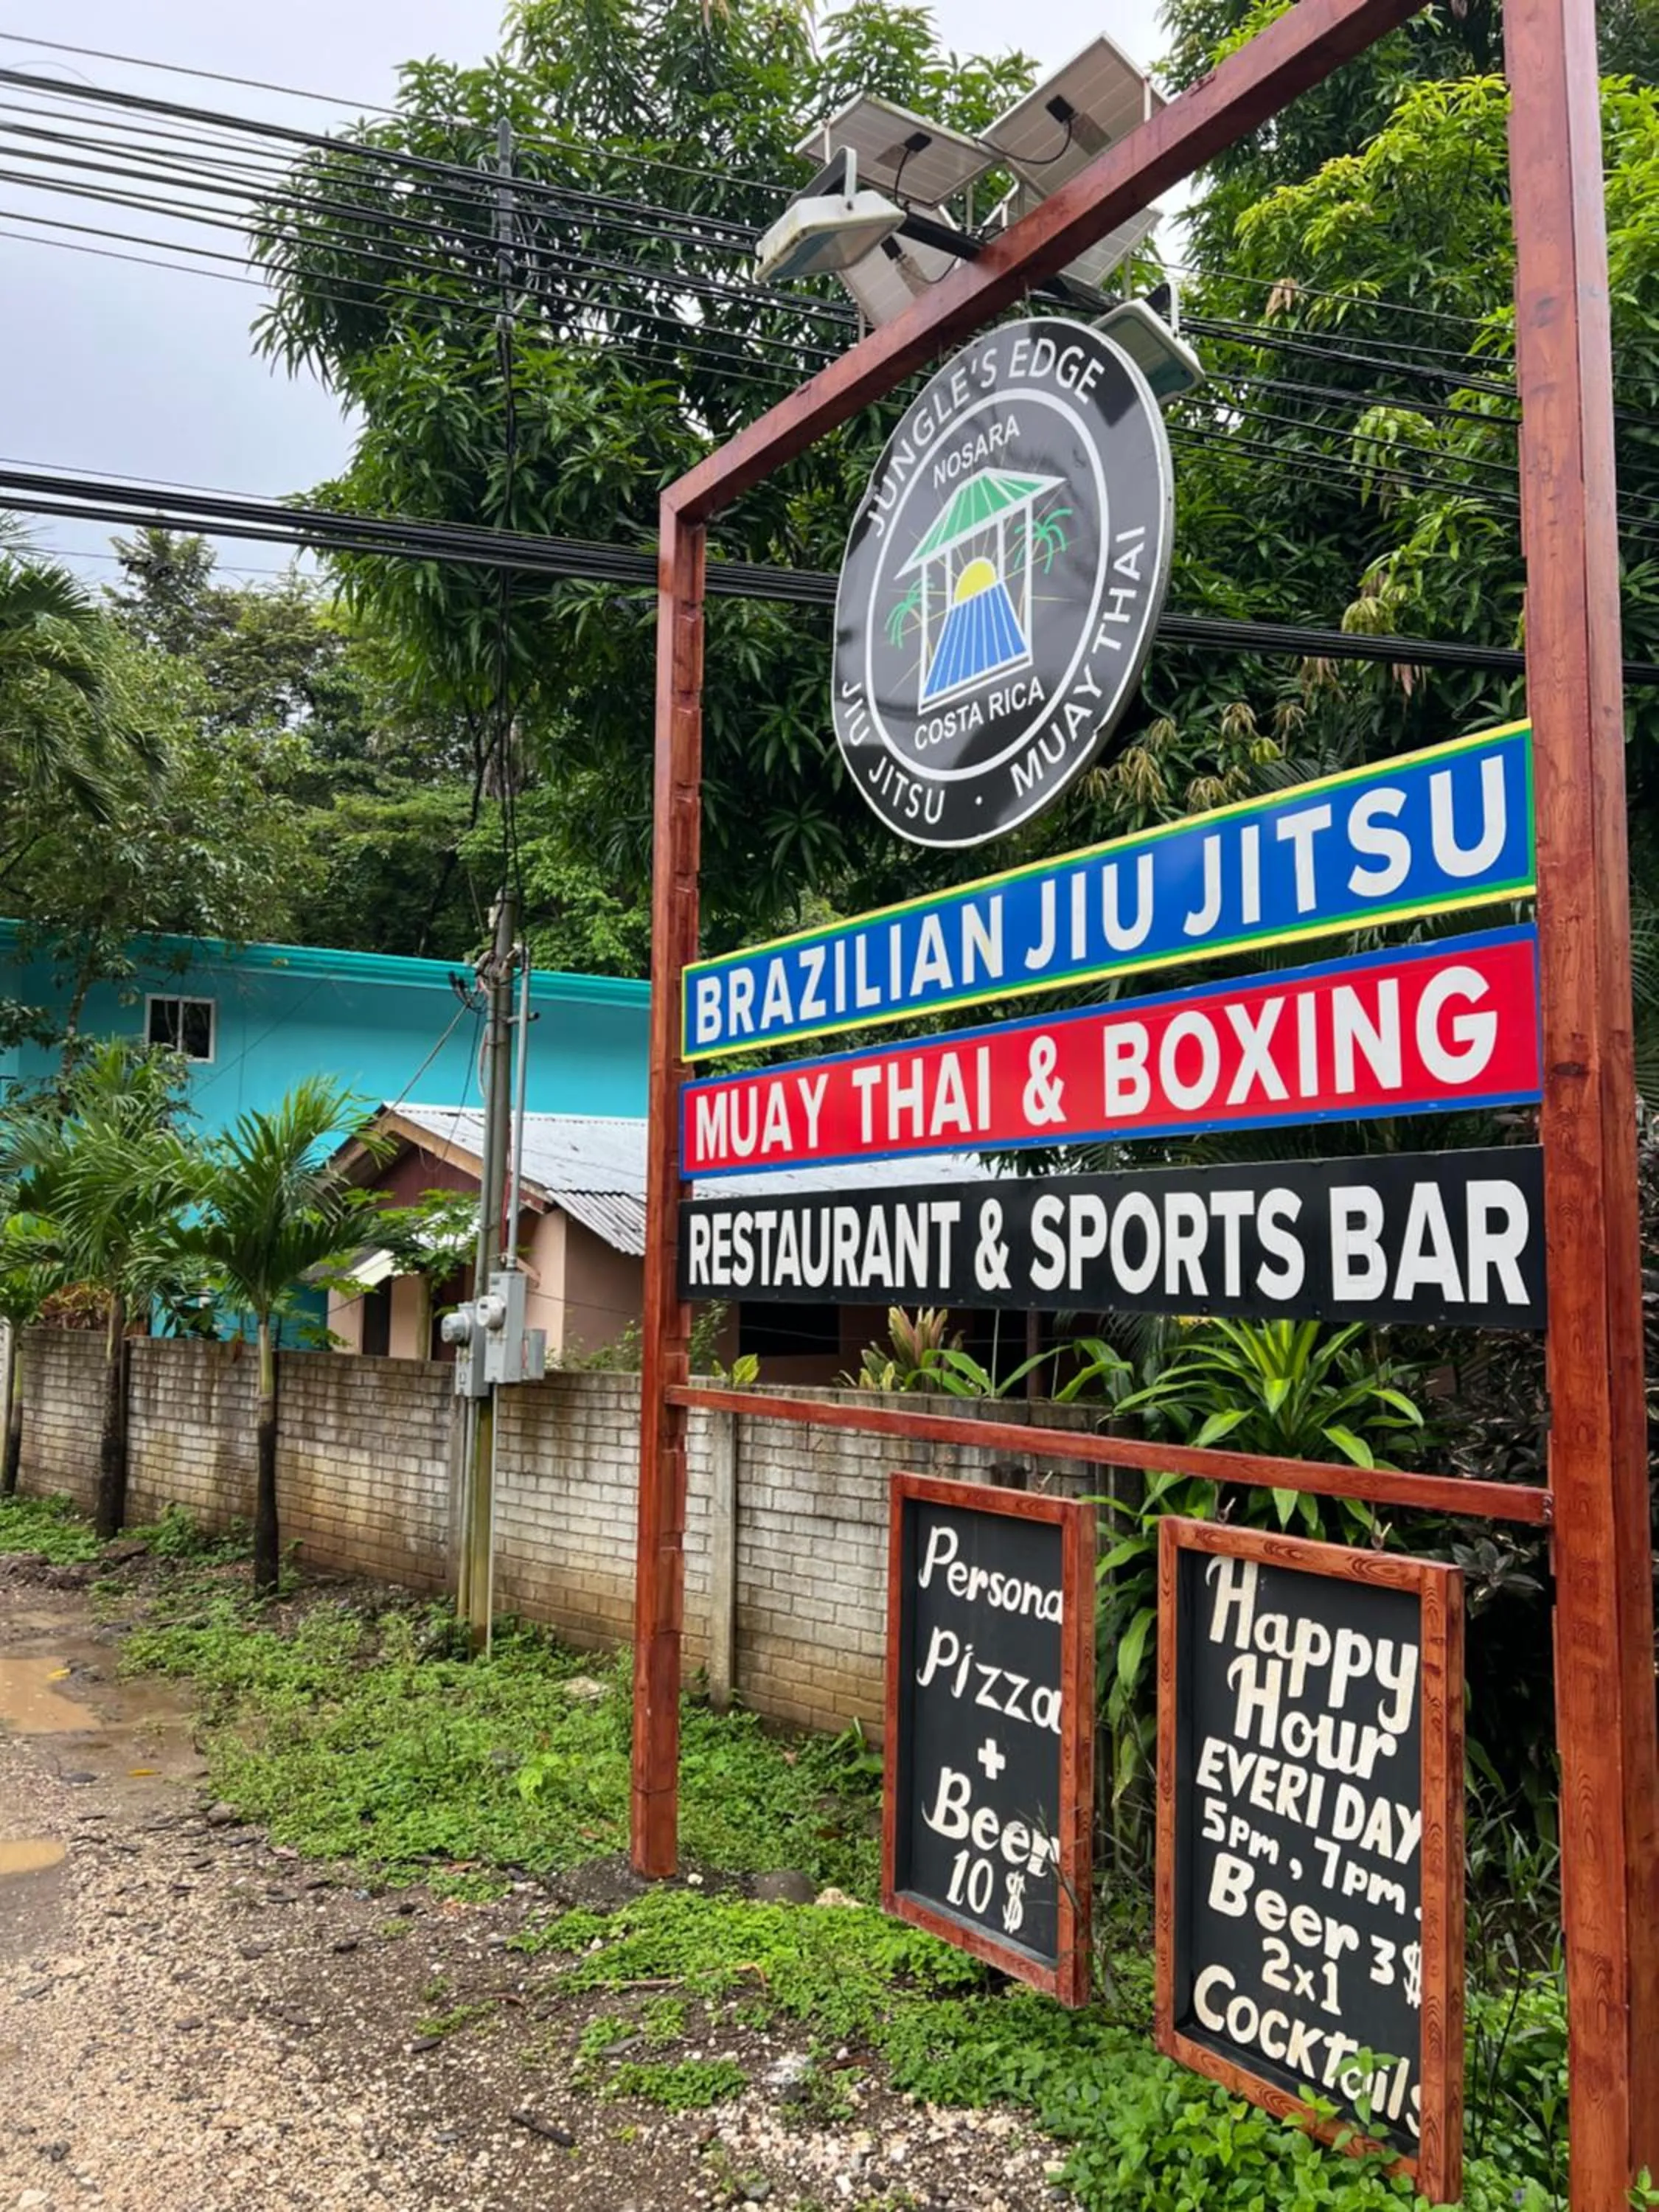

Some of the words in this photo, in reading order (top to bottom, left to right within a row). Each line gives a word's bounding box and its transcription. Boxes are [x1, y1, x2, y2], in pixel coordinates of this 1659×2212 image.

[867, 348, 998, 537] JUNGLE'S
[1008, 338, 1105, 405] EDGE
[933, 414, 1021, 490] NOSARA
[914, 692, 985, 751] COSTA
[988, 675, 1046, 720] RICA
[1010, 662, 1102, 798] MUAY
[1091, 524, 1147, 655] THAI
[841, 680, 871, 747] JIU
[868, 756, 946, 825] JITSU
[696, 895, 1004, 1044] BRAZILIAN
[1026, 853, 1154, 970] JIU
[1183, 755, 1506, 936] JITSU
[695, 1074, 829, 1161] MUAY
[851, 1047, 992, 1144] THAI
[1023, 1035, 1066, 1127] &
[1104, 966, 1498, 1118] BOXING
[689, 1200, 961, 1289] RESTAURANT
[974, 1198, 1012, 1291] &
[1029, 1186, 1305, 1300] SPORTS
[1329, 1180, 1531, 1304] BAR
[916, 1626, 1062, 1735] Pizza
[1206, 1555, 1419, 1736] Happy
[977, 1737, 1006, 1780] +
[1226, 1653, 1398, 1781] Hour
[922, 1766, 1061, 1877] Beer
[1195, 1736, 1325, 1829] EVERI
[1332, 1782, 1422, 1865] DAY
[946, 1848, 994, 1914] 10
[1002, 1871, 1026, 1934] $
[1208, 1851, 1360, 1961] Beer
[1262, 1935, 1343, 2017] 2x1
